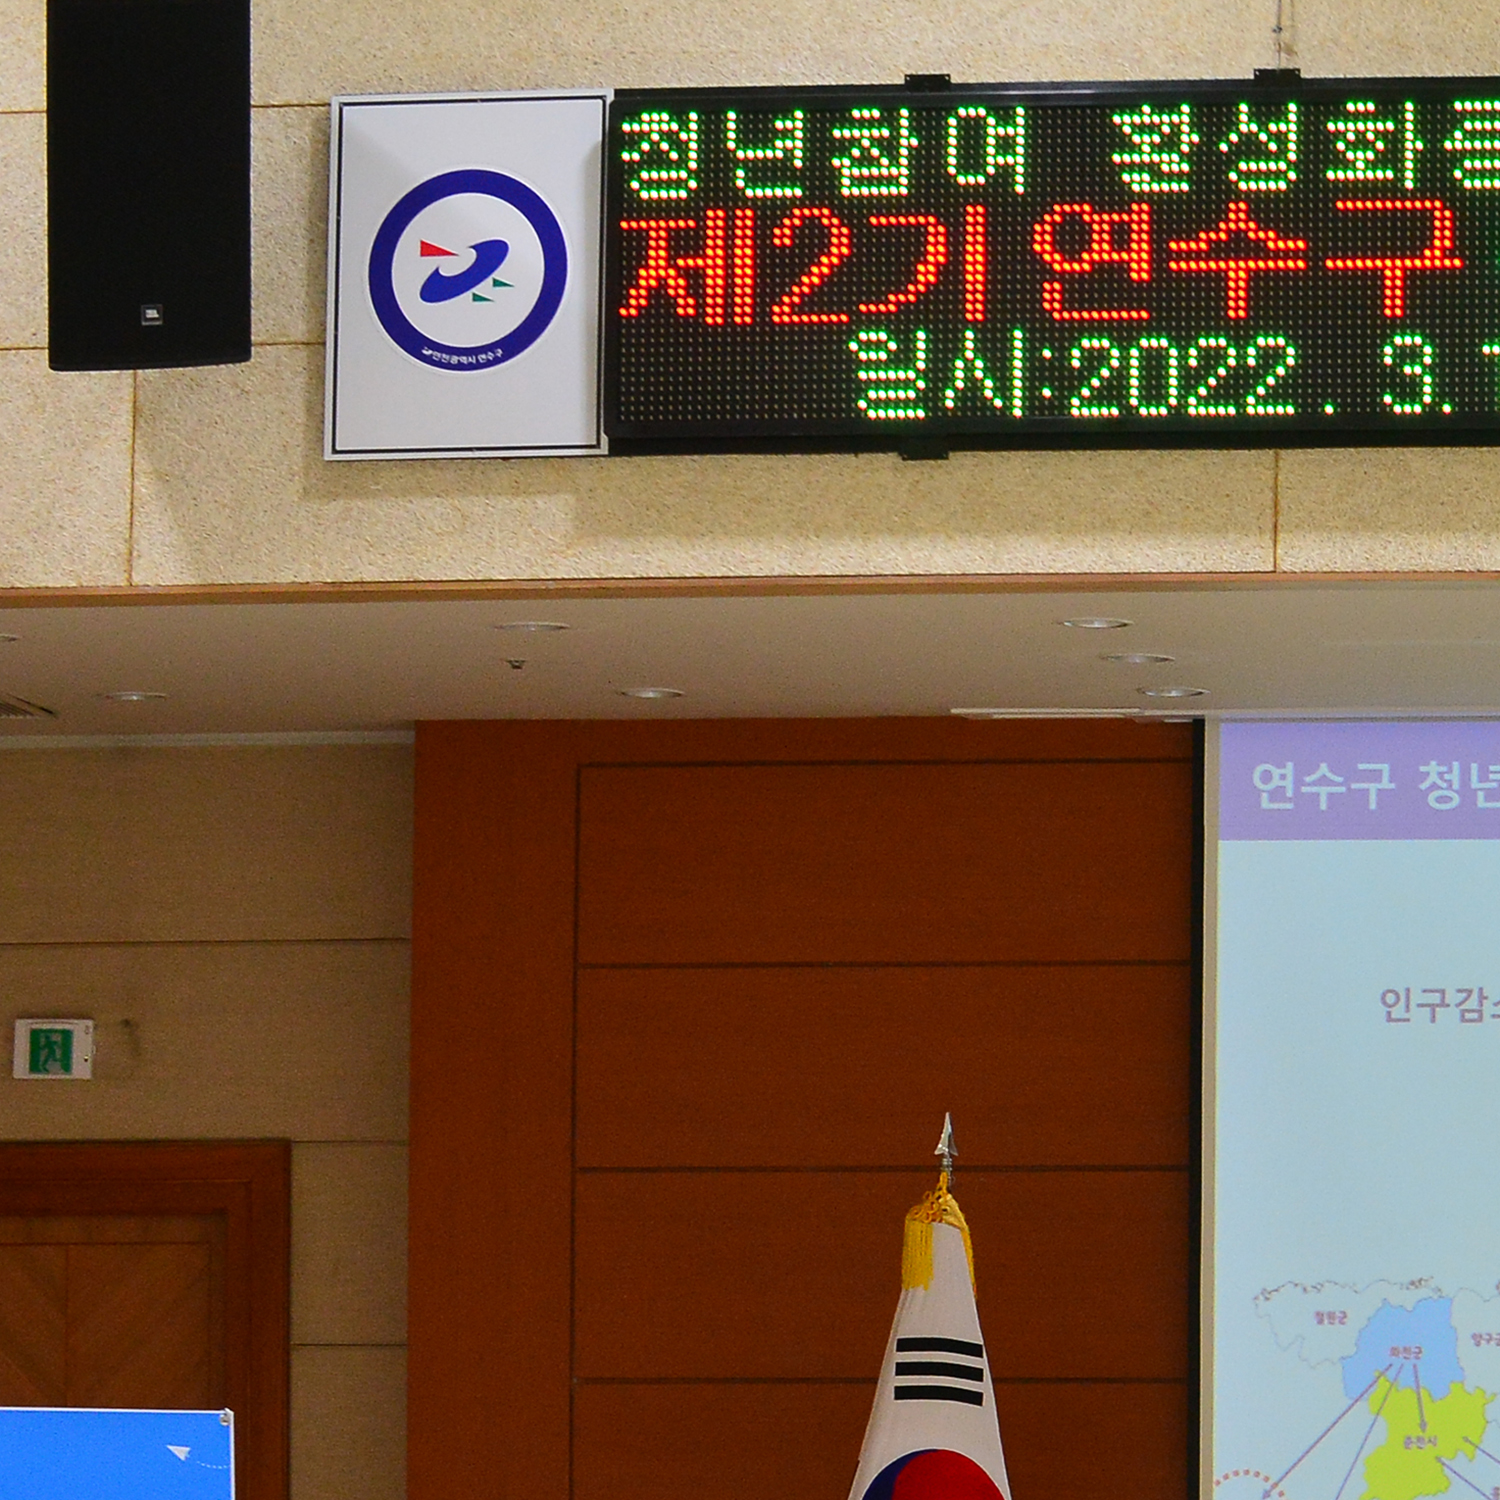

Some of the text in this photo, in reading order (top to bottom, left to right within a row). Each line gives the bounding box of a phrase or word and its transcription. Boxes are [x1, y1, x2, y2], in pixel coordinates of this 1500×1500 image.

[620, 104, 1026, 199] 청년참여
[618, 204, 986, 326] 제2기
[1031, 199, 1465, 322] 연수구
[848, 328, 1334, 419] 일시:2022.
[1382, 333, 1453, 415] 3.
[1251, 761, 1397, 810] 연수구
